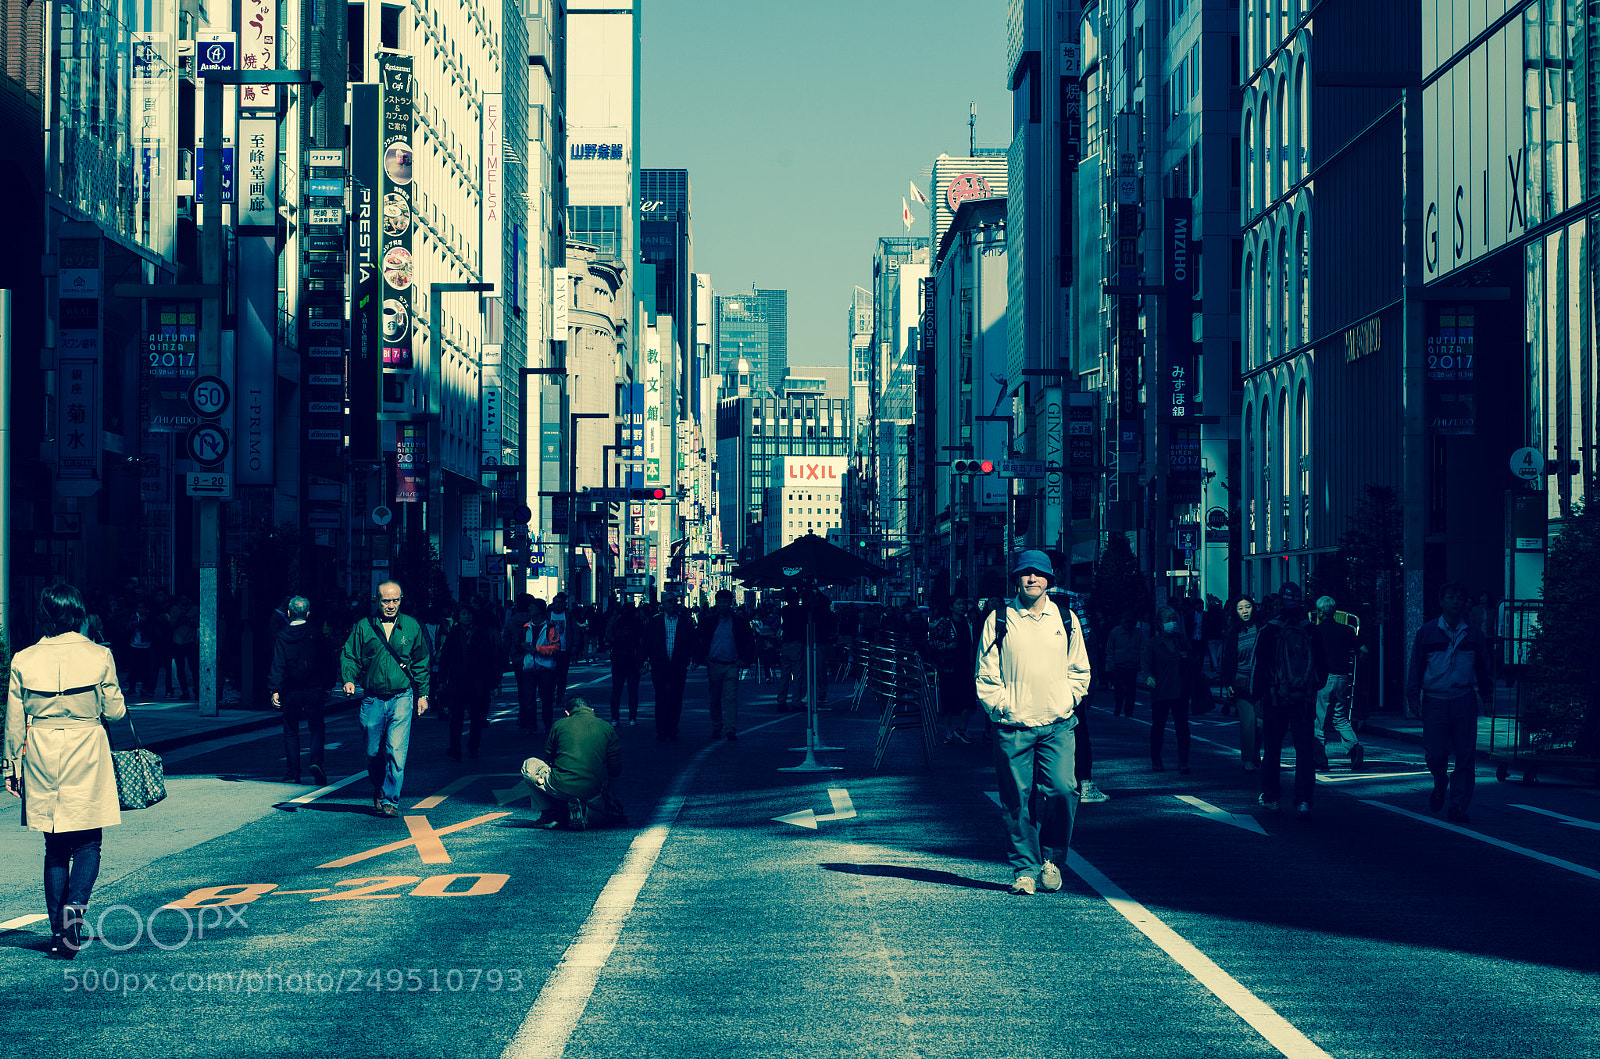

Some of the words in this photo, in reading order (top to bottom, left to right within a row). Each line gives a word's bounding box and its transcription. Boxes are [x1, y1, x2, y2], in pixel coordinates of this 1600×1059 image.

[570, 143, 624, 160] 山野楽器
[249, 133, 265, 212] 至峰堂画廊
[1174, 218, 1187, 281] MIZUHO
[926, 281, 935, 348] MITSUKOSHI
[149, 333, 196, 342] AUTUMN
[1428, 336, 1474, 344] AUTUMN
[149, 342, 184, 351] GINZA
[1428, 345, 1463, 353] GINZA
[149, 352, 195, 367] 2017
[1427, 355, 1473, 369] 2017
[646, 348, 659, 422] 教文館
[197, 387, 220, 406] 50
[487, 391, 496, 426] PLAZA
[66, 403, 87, 450] 菊水
[249, 388, 262, 473] I-PRIMO
[397, 453, 425, 463] 2017
[1170, 456, 1200, 466] 2017
[1522, 450, 1533, 467] 4
[647, 461, 658, 478] 本
[789, 463, 837, 481] LIXIL
[530, 556, 545, 564] GU
